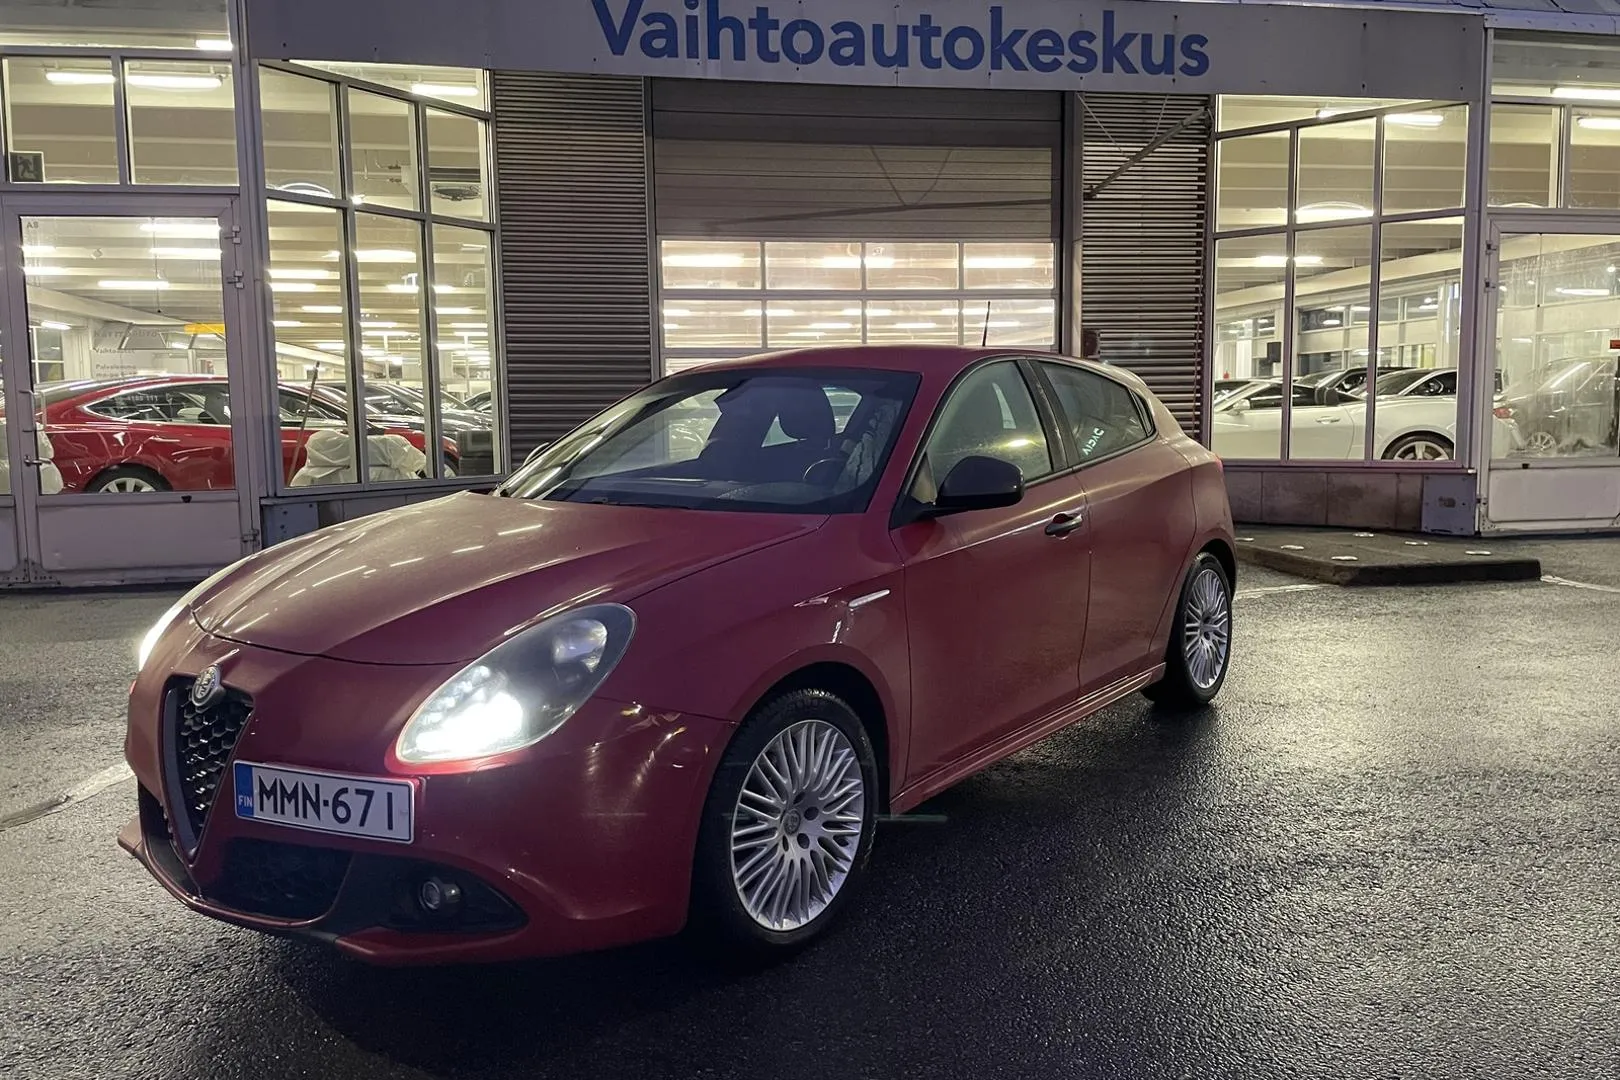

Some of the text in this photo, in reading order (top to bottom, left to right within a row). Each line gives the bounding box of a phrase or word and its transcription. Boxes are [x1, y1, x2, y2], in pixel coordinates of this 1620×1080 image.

[590, 0, 1209, 76] Vaihtoautokeskus
[238, 795, 253, 808] FIN
[258, 775, 394, 831] MMN-671
